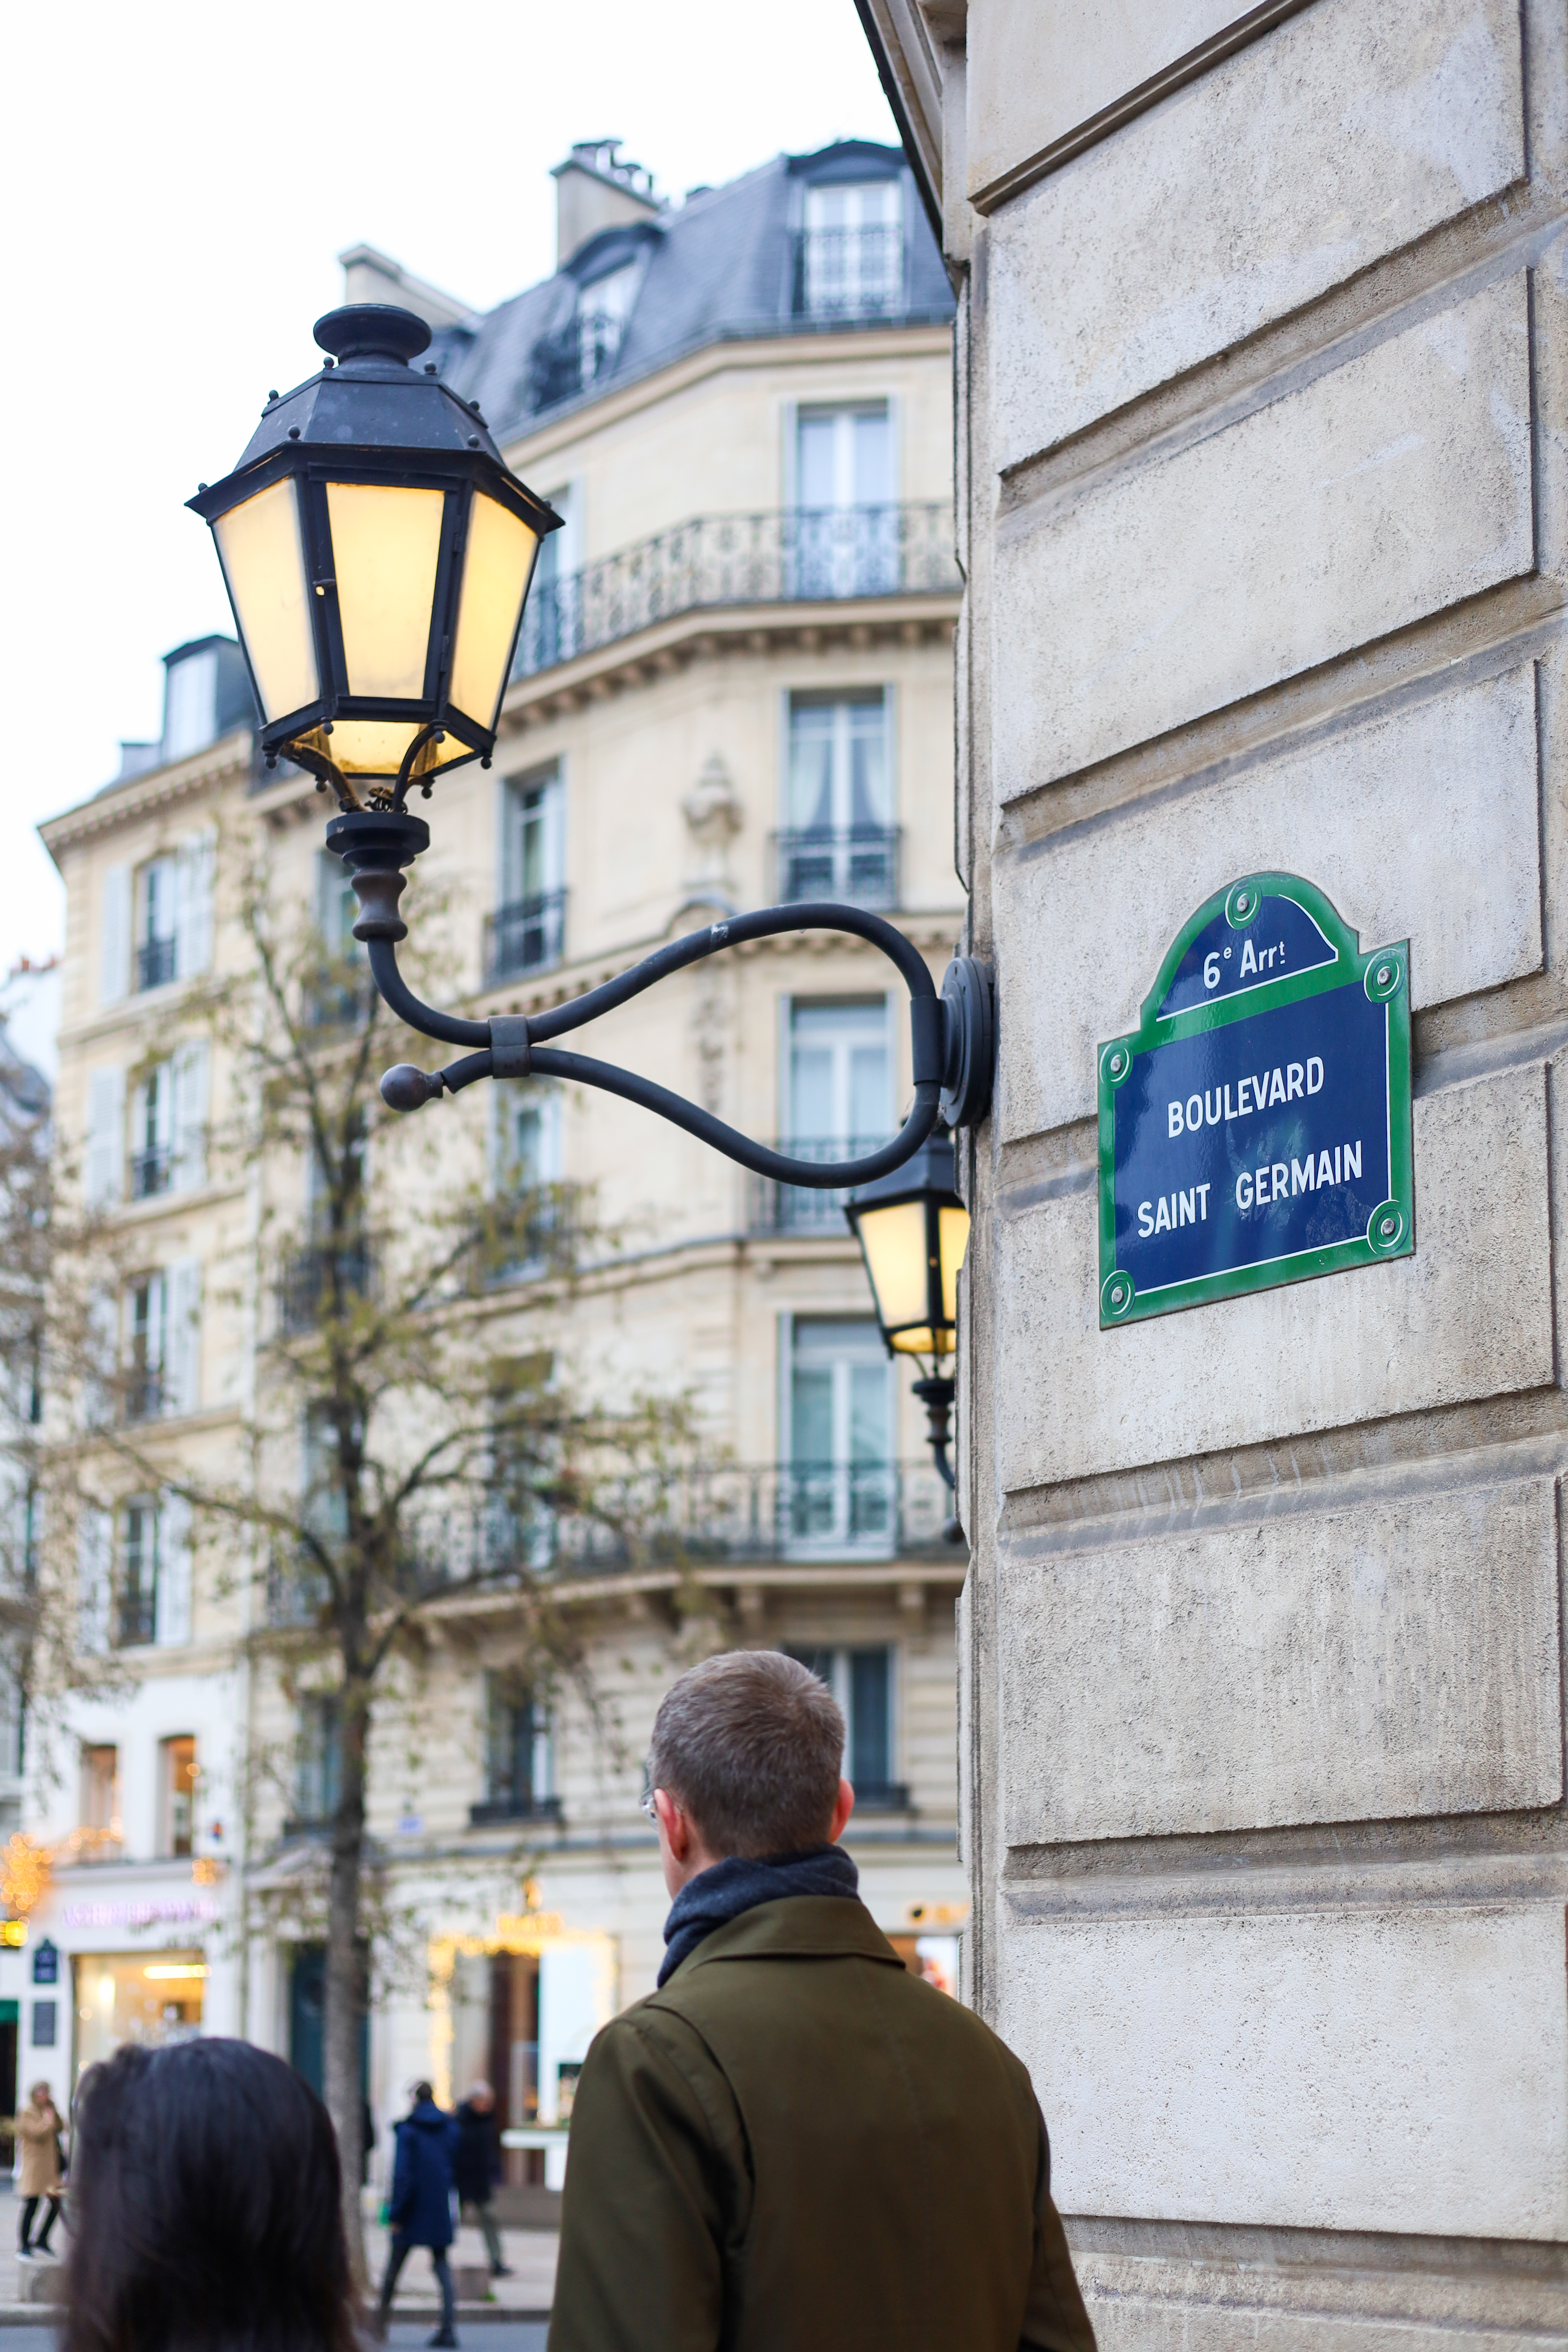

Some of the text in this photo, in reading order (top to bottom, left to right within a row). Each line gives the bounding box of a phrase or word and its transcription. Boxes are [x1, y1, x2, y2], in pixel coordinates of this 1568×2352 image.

[1204, 947, 1232, 989] 6e
[1168, 1057, 1324, 1138] BOULEVARD
[1138, 1140, 1362, 1238] SAINT GERMAIN
